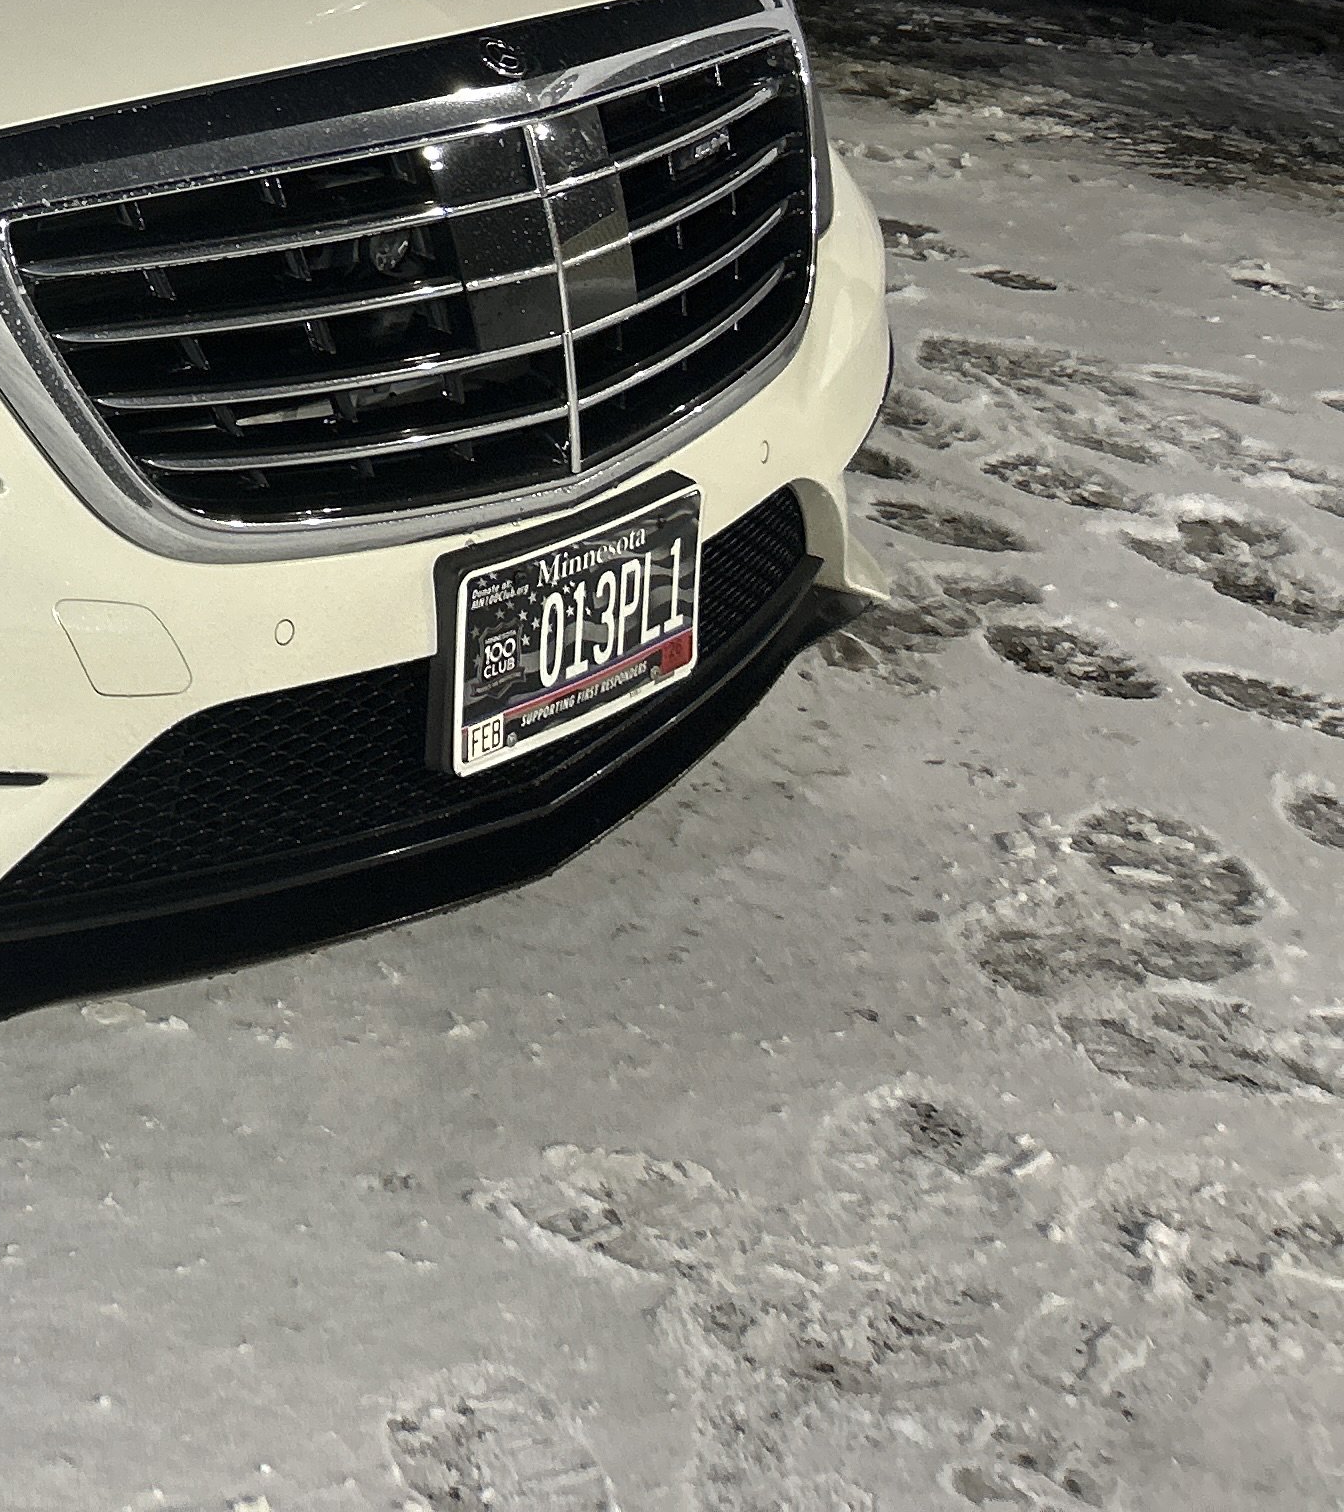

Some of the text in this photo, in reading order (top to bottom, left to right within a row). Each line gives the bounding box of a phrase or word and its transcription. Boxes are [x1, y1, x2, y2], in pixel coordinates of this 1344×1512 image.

[536, 528, 647, 588] Minnesota
[539, 537, 684, 688] 013PL1
[483, 656, 516, 679] CLUB
[484, 637, 516, 665] 100
[521, 660, 648, 727] SUPPORTING FIRST RESPONDERS
[471, 717, 502, 758] FEB
